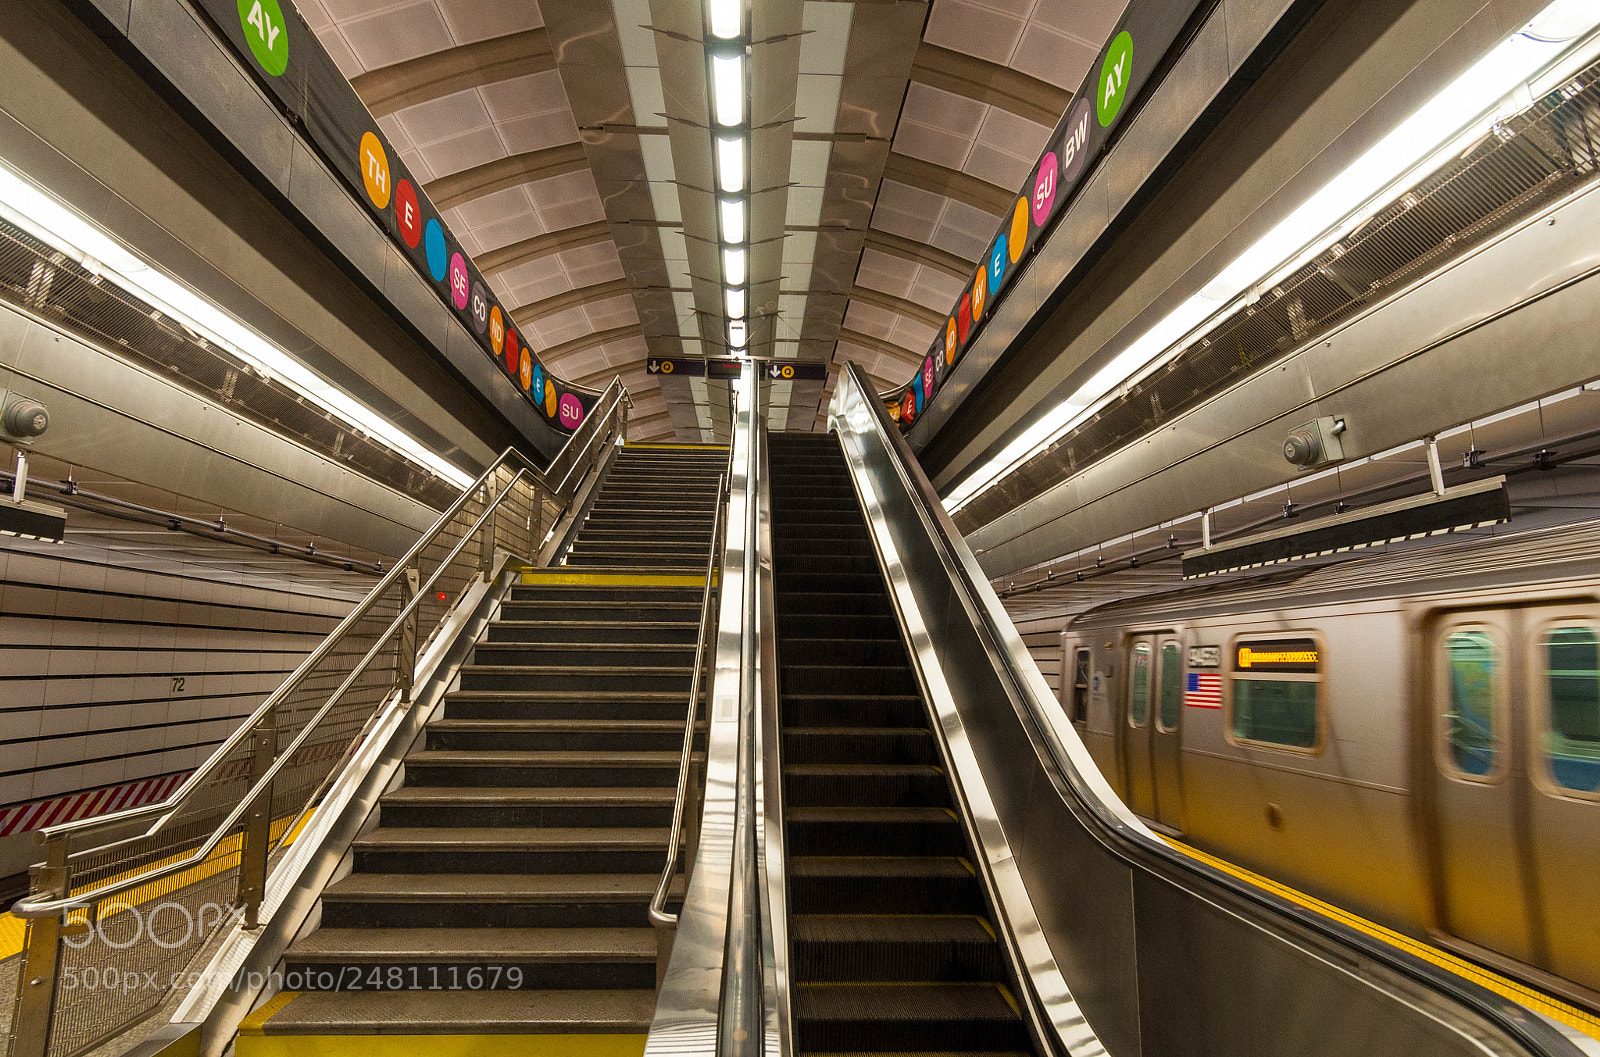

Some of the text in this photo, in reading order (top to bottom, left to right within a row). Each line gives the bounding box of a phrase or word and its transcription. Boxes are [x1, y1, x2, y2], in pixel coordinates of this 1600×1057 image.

[247, 0, 280, 51] AY
[366, 149, 386, 194] TH
[404, 201, 414, 230] E
[453, 267, 466, 297] SE
[473, 295, 486, 322] CO
[491, 318, 502, 343] ND
[561, 403, 579, 420] SU
[935, 350, 944, 372] CO
[946, 330, 955, 354] ND
[974, 279, 984, 309] AV
[994, 253, 1001, 278] E
[1036, 169, 1053, 210] SU
[1065, 111, 1089, 169] BW
[1104, 51, 1126, 110] AY
[172, 677, 185, 692] 72
